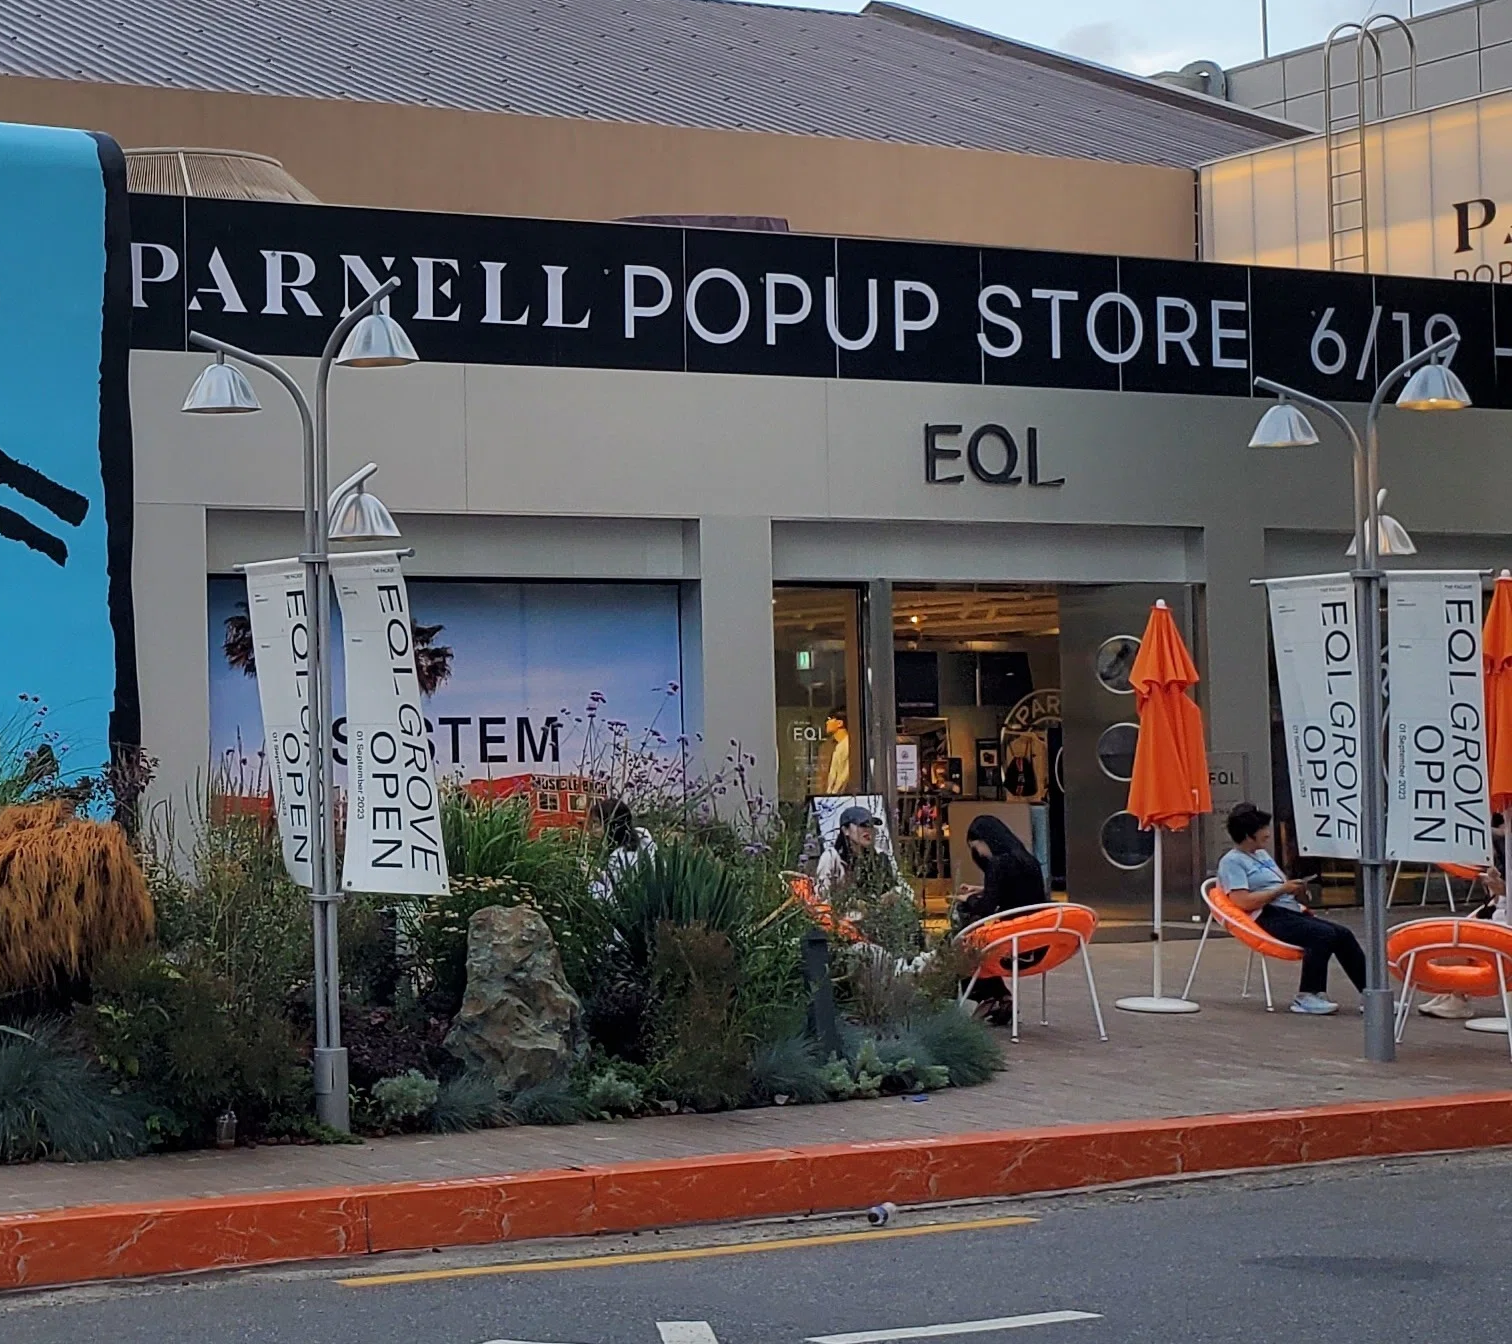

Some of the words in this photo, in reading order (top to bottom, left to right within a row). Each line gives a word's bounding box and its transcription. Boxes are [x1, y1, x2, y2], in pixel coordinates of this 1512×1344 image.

[1452, 199, 1512, 253] P
[130, 242, 591, 329] PARNELL
[624, 264, 940, 352] POPUP
[977, 284, 1249, 369] STORE
[924, 422, 1065, 486] EQL
[1321, 601, 1352, 696] EQL
[1445, 599, 1477, 696] EQL
[355, 743, 365, 794] September
[356, 730, 364, 742] 01
[377, 584, 413, 696] EQL
[398, 703, 442, 876] GROVE
[793, 726, 828, 742] EQL
[1303, 725, 1333, 838] OPEN
[1329, 701, 1359, 844] GROVE
[1450, 702, 1486, 851] GROVE
[282, 732, 308, 863] OPEN
[356, 796, 365, 820] 2023
[370, 731, 404, 868] OPEN
[1413, 725, 1447, 843] OPEN
